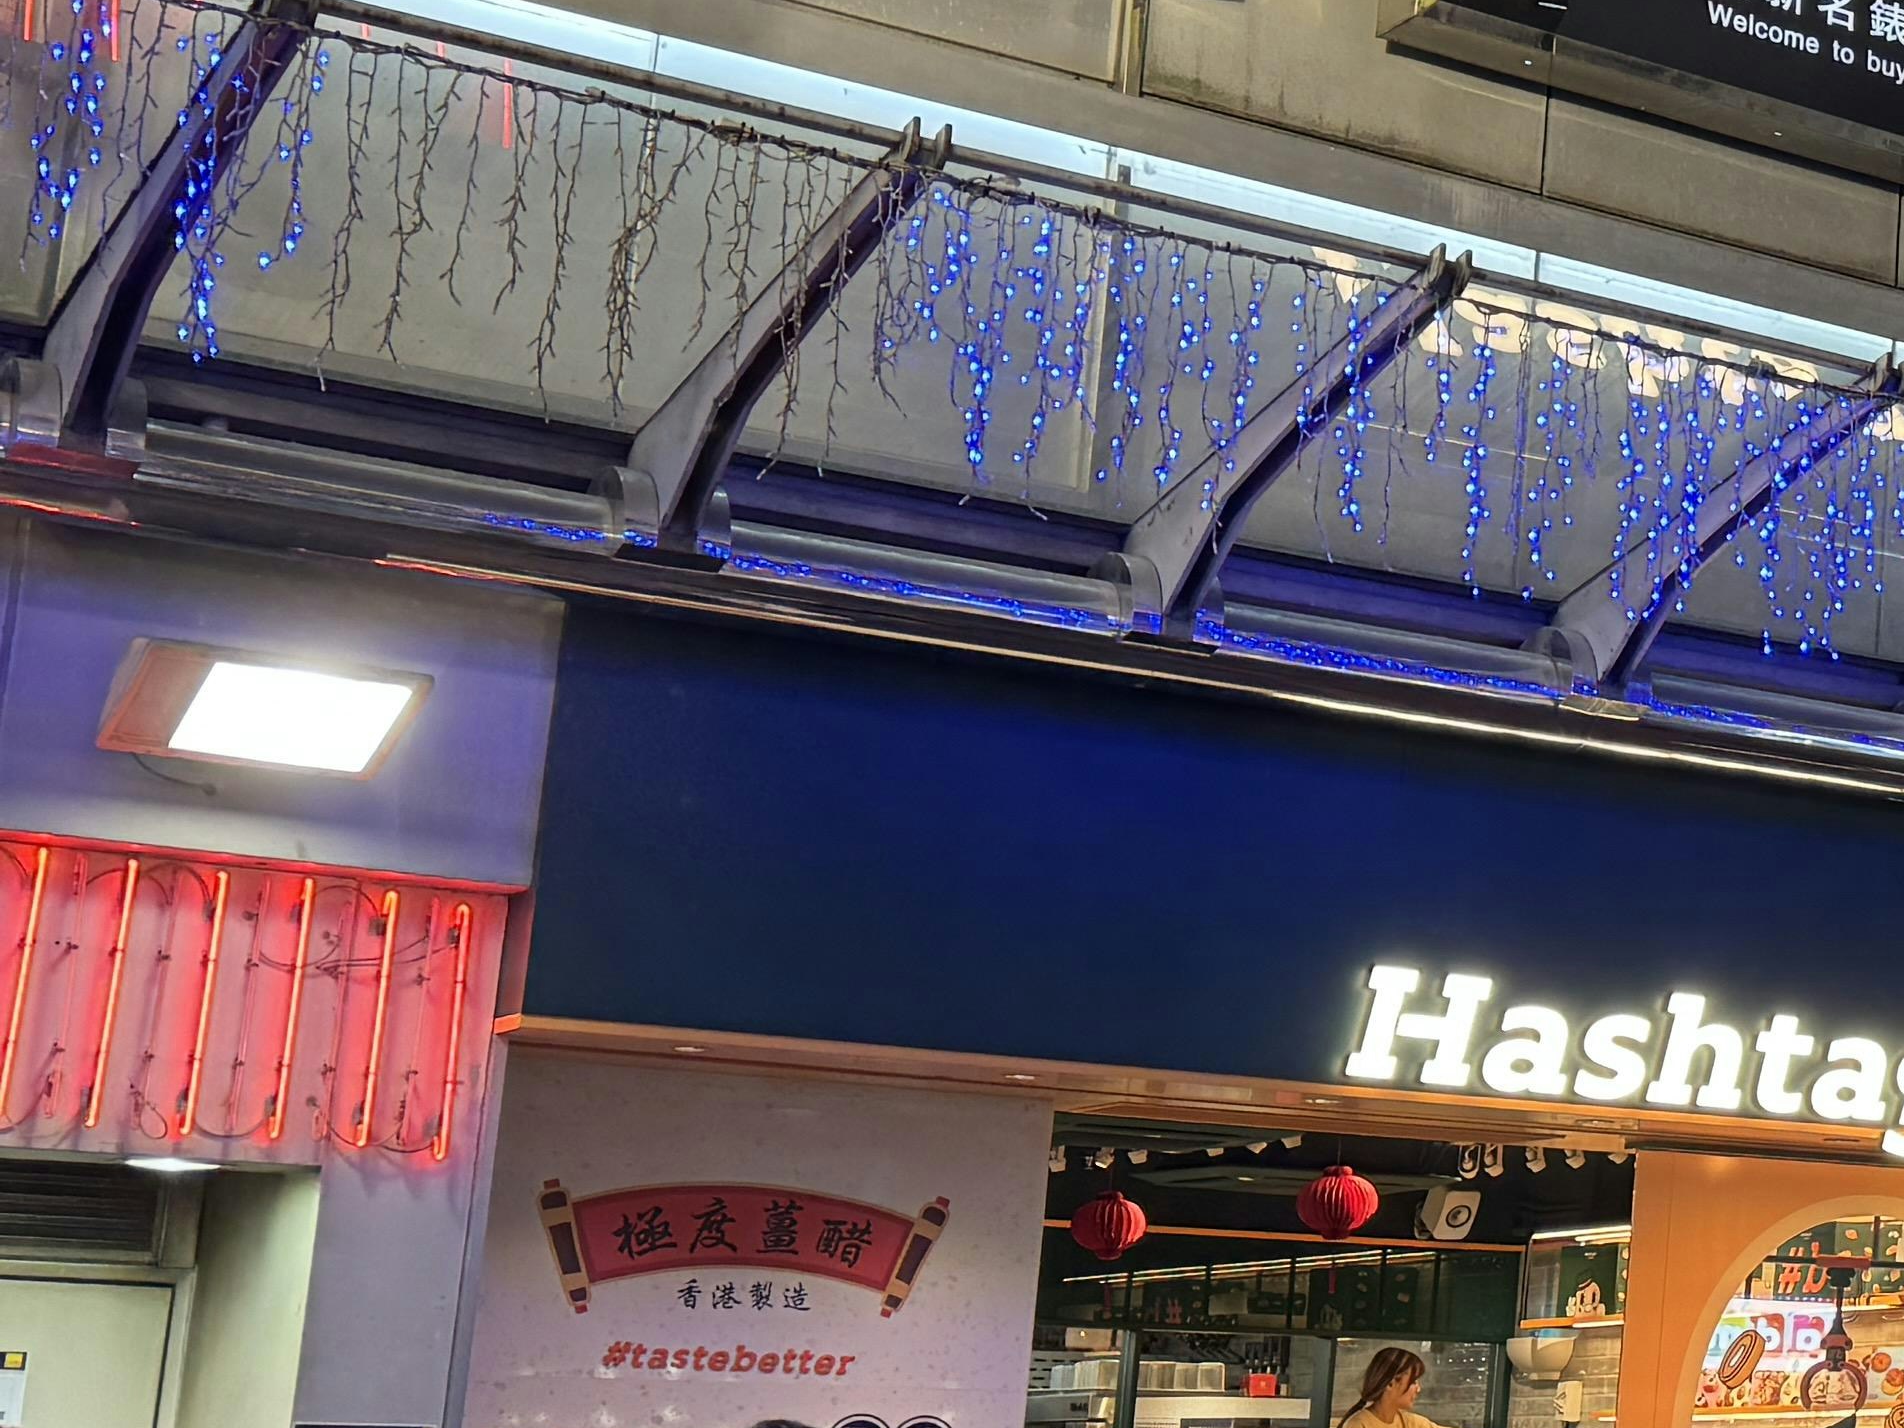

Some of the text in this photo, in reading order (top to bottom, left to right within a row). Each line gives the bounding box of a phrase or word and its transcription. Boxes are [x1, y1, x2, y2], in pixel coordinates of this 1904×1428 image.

[1708, 0, 1820, 59] Welcome
[1832, 37, 1856, 66] to
[611, 1197, 874, 1268] 極度薑醋
[675, 1278, 812, 1312] 香港製造
[600, 1341, 856, 1377] #tastebetter
